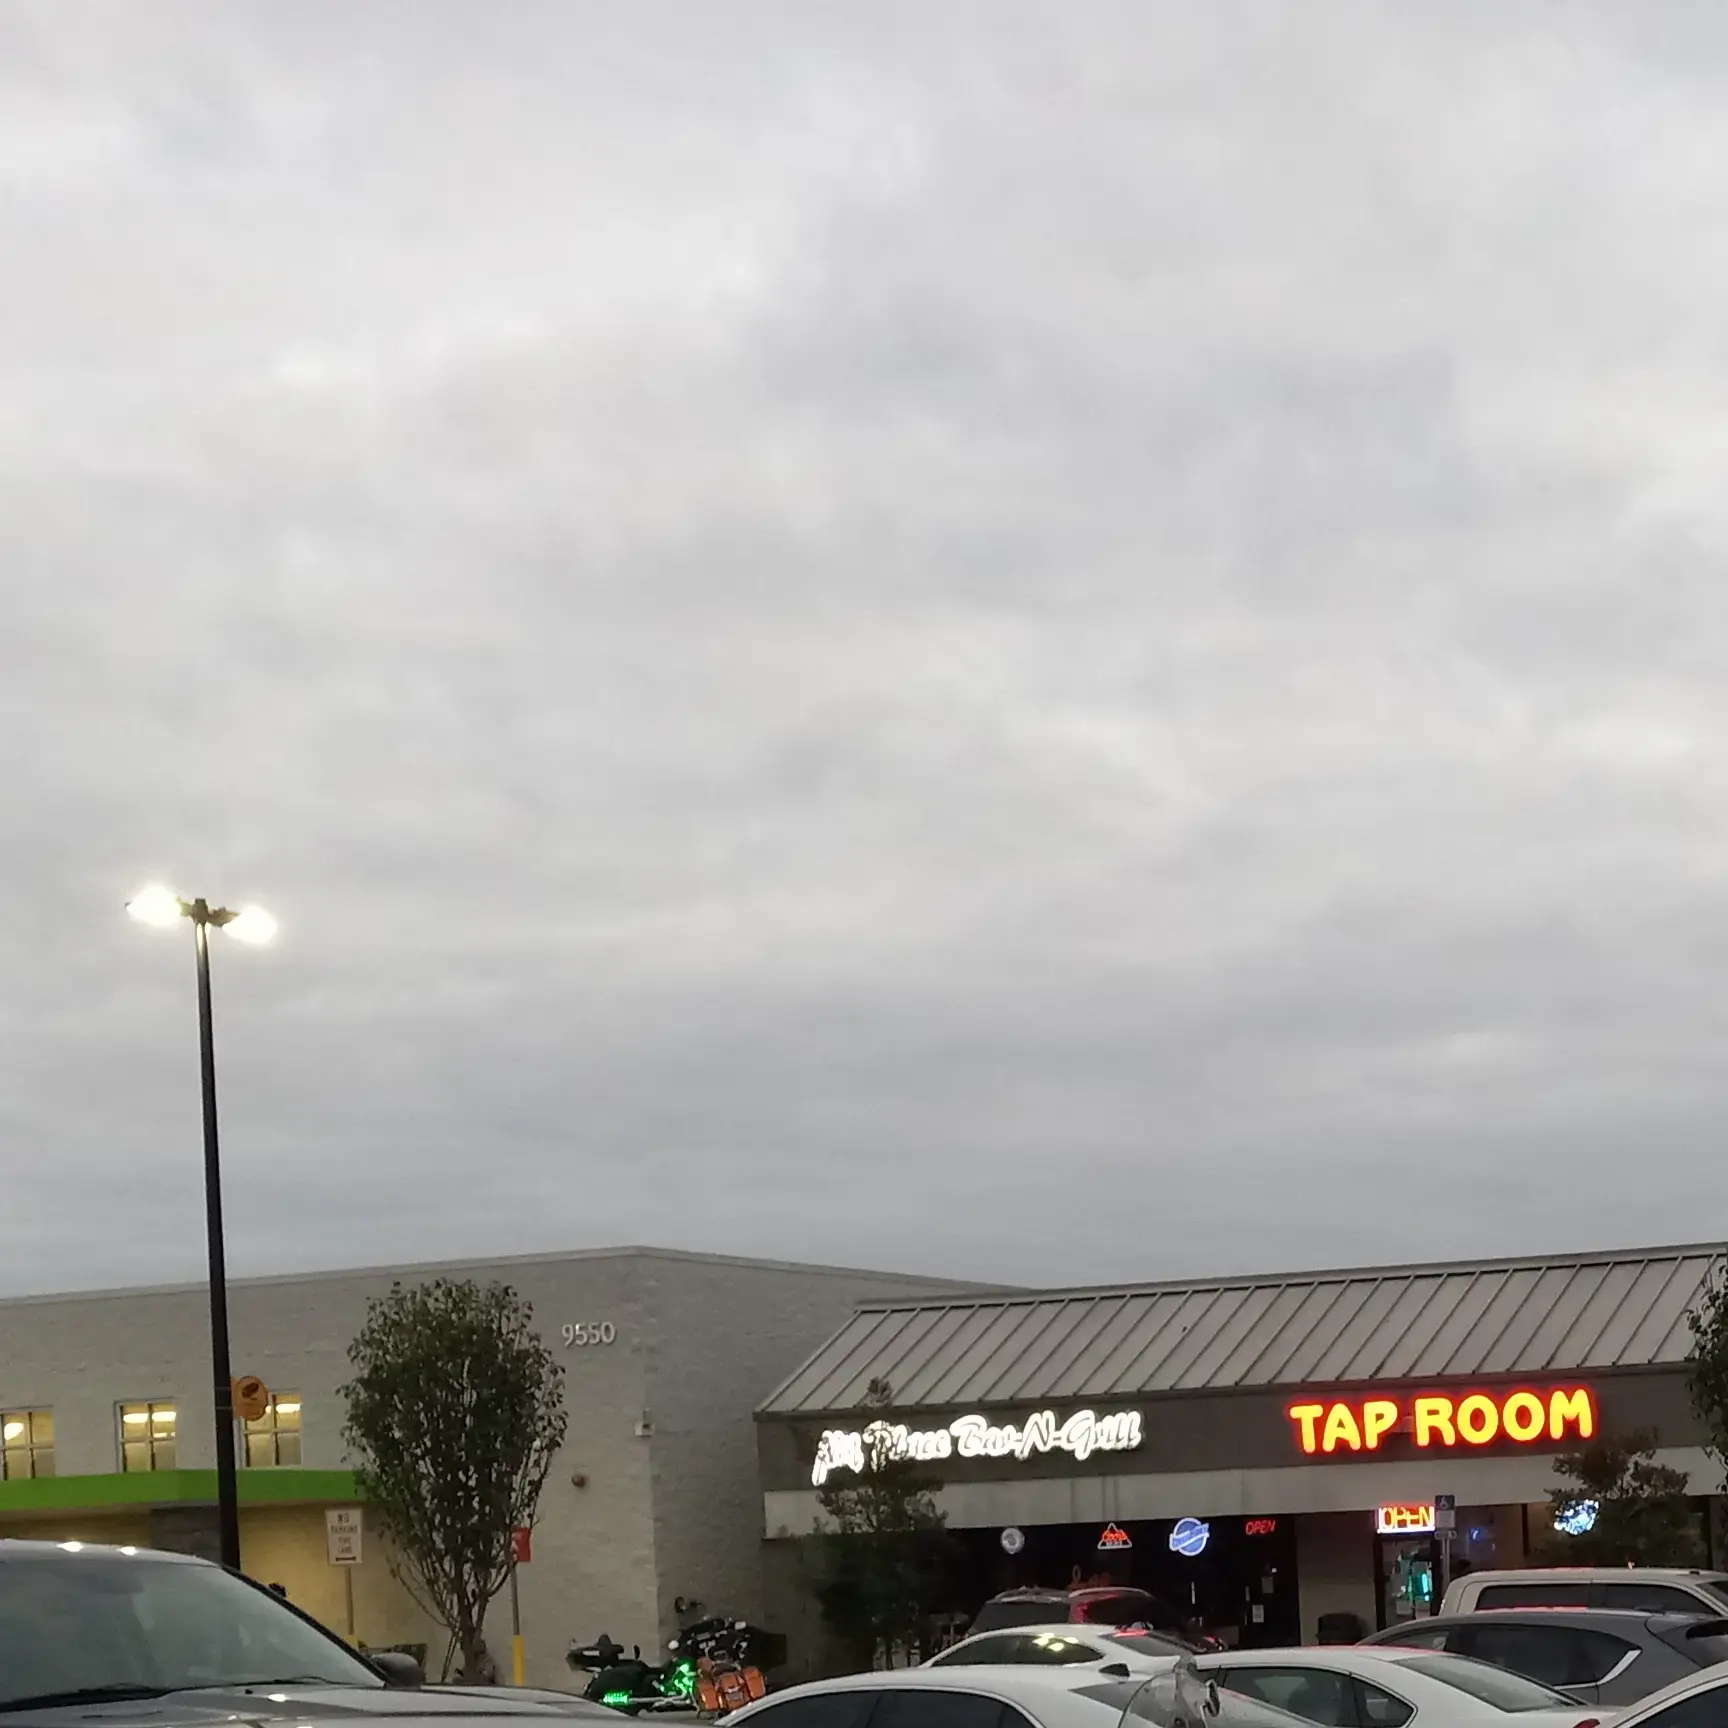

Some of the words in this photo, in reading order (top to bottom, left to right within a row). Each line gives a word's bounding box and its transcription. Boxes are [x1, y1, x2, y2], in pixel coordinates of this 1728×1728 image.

[561, 1321, 616, 1348] 9550
[1289, 1399, 1399, 1454] TAP
[1413, 1387, 1597, 1448] ROOM
[1245, 1519, 1276, 1535] OPEN
[1378, 1505, 1436, 1530] OPEN
